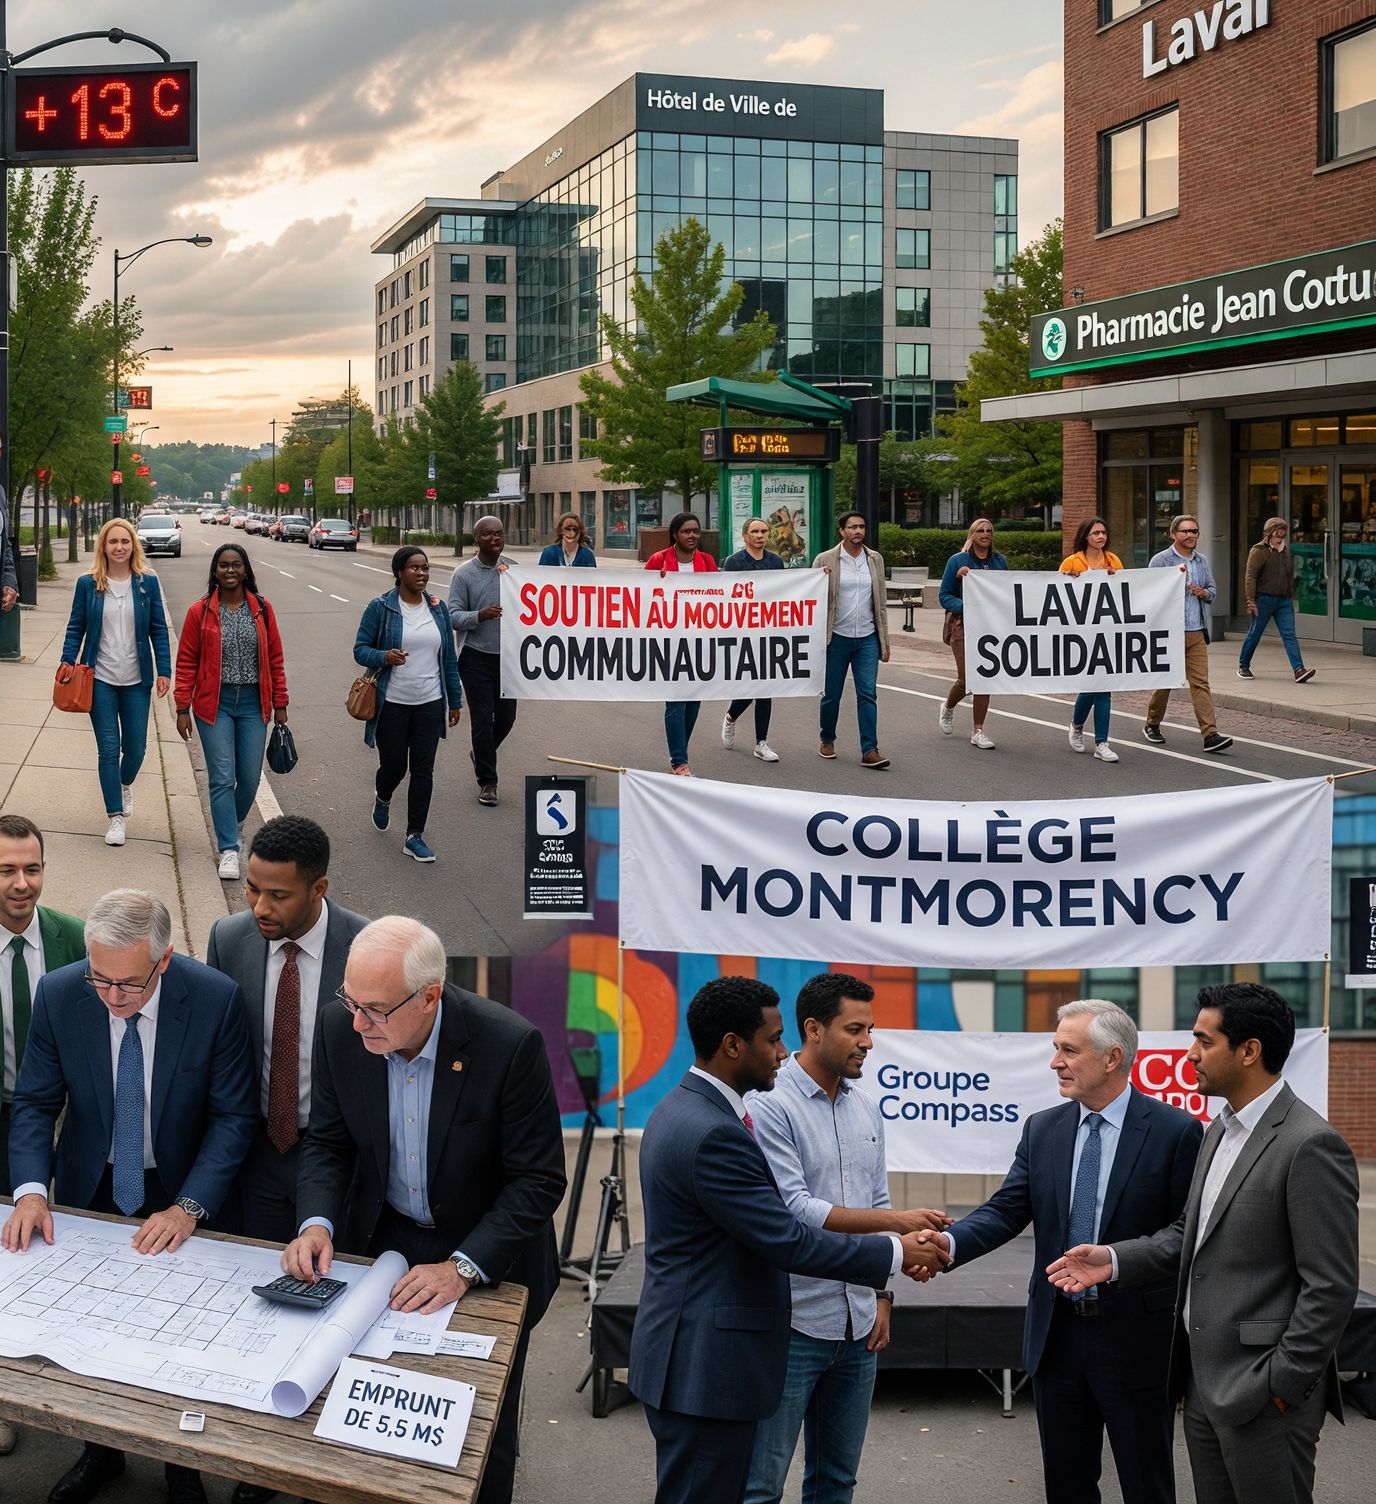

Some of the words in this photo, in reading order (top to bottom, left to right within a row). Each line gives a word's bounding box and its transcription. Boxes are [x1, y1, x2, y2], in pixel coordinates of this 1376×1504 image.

[26, 82, 131, 140] +13
[153, 78, 179, 116] C
[647, 88, 697, 110] Hôtel
[702, 92, 725, 112] de
[729, 94, 770, 115] Ville
[774, 98, 797, 117] de
[1077, 293, 1205, 350] Pharmacie
[1211, 285, 1276, 334] Jean
[1283, 265, 1376, 313] Cottu
[519, 582, 641, 628] SOUTIEN
[684, 599, 817, 629] MOUVEMENT
[1013, 582, 1146, 626] LAVAL
[520, 634, 811, 682] COMMUNAUTAIRE
[976, 630, 1171, 678] SOLIDAIRE
[806, 809, 1117, 864] COLLÈGE
[700, 864, 1246, 928] MONTMORENCY
[877, 1064, 990, 1097] Groupe
[879, 1094, 1019, 1128] Compass
[348, 1379, 457, 1420] EMPRUNT
[344, 1407, 373, 1430] DE
[376, 1414, 408, 1438] 5,5
[411, 1422, 445, 1447] M$
